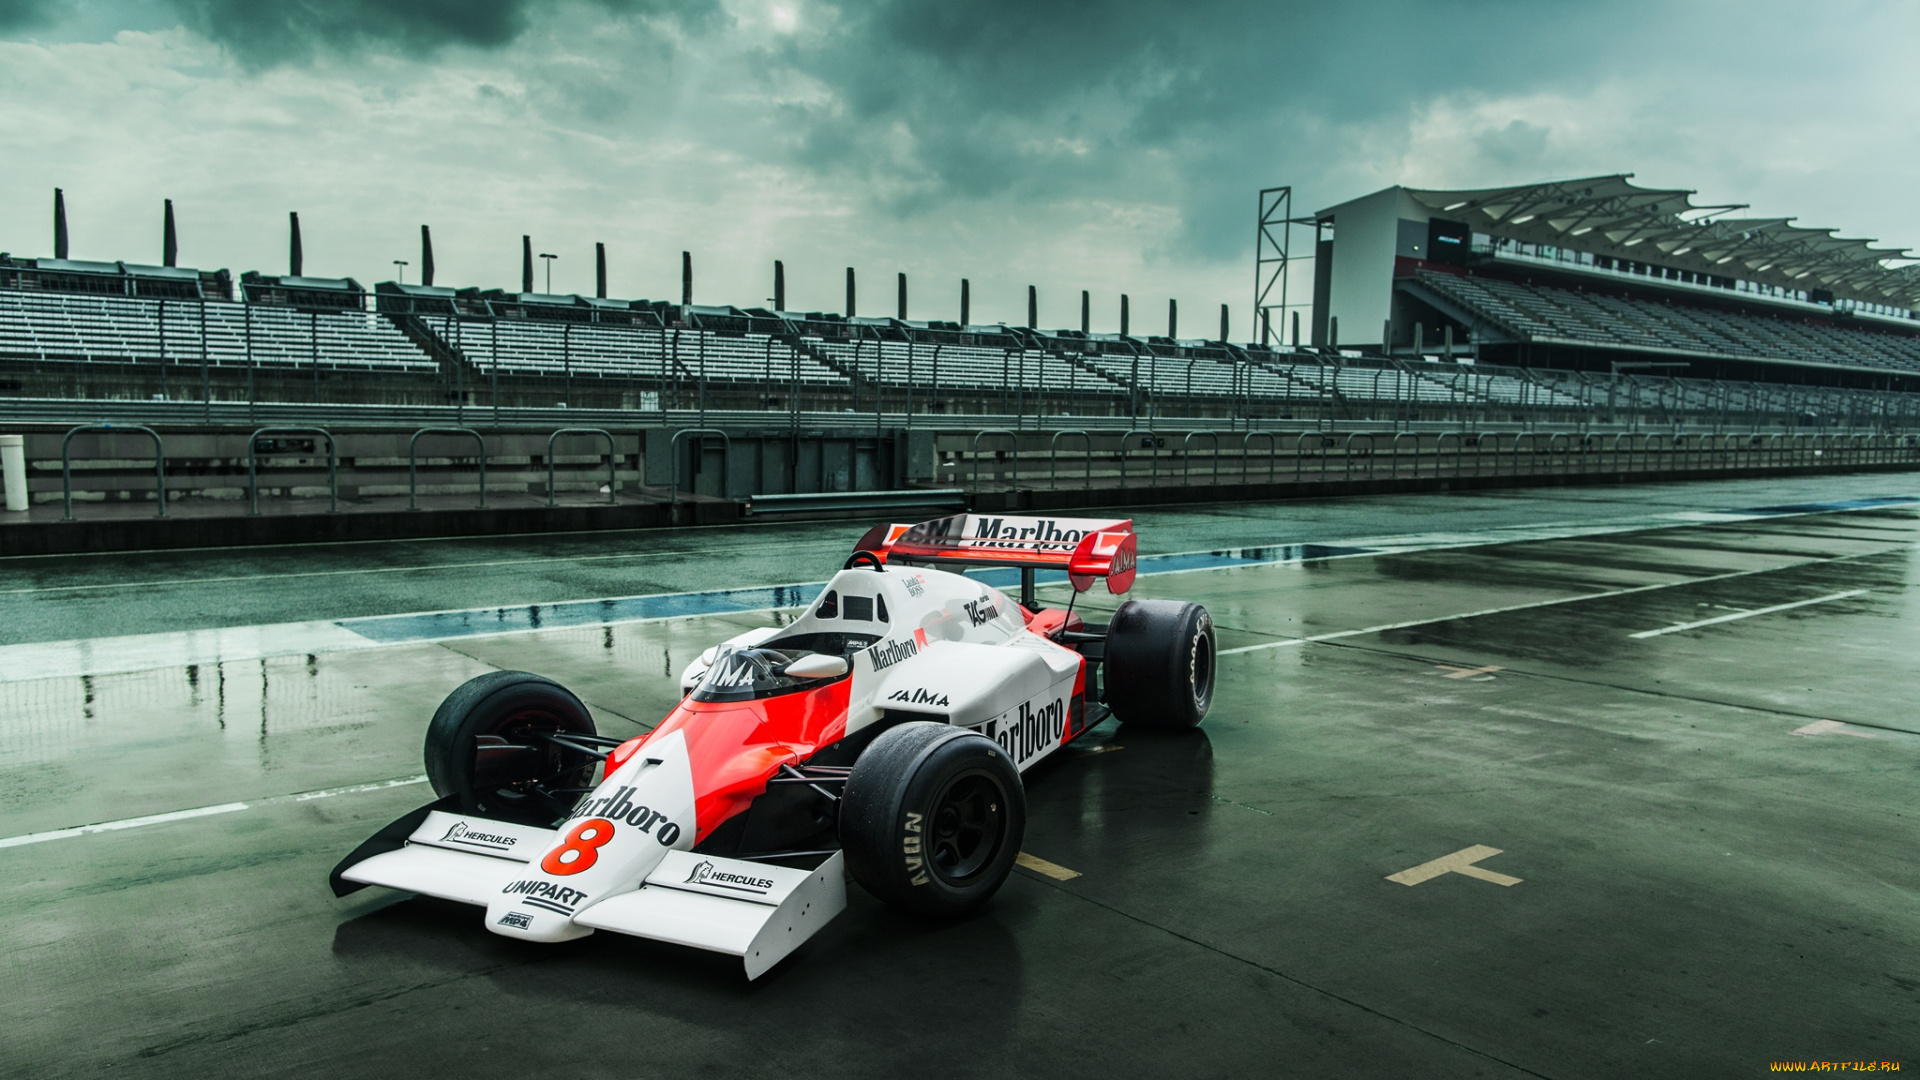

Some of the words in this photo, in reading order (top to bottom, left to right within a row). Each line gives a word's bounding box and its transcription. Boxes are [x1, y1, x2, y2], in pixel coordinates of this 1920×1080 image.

[970, 517, 1097, 549] Marlbo
[908, 585, 925, 597] BOSS
[867, 638, 918, 672] Marlboro
[887, 687, 950, 707] SAIMA
[570, 786, 681, 847] arlboro
[463, 831, 518, 846] HERCULES
[541, 818, 615, 876] 8
[903, 812, 930, 886] AVON
[502, 880, 588, 906] UNIPART
[711, 871, 774, 889] HERCULES
[501, 916, 528, 928] MP4
